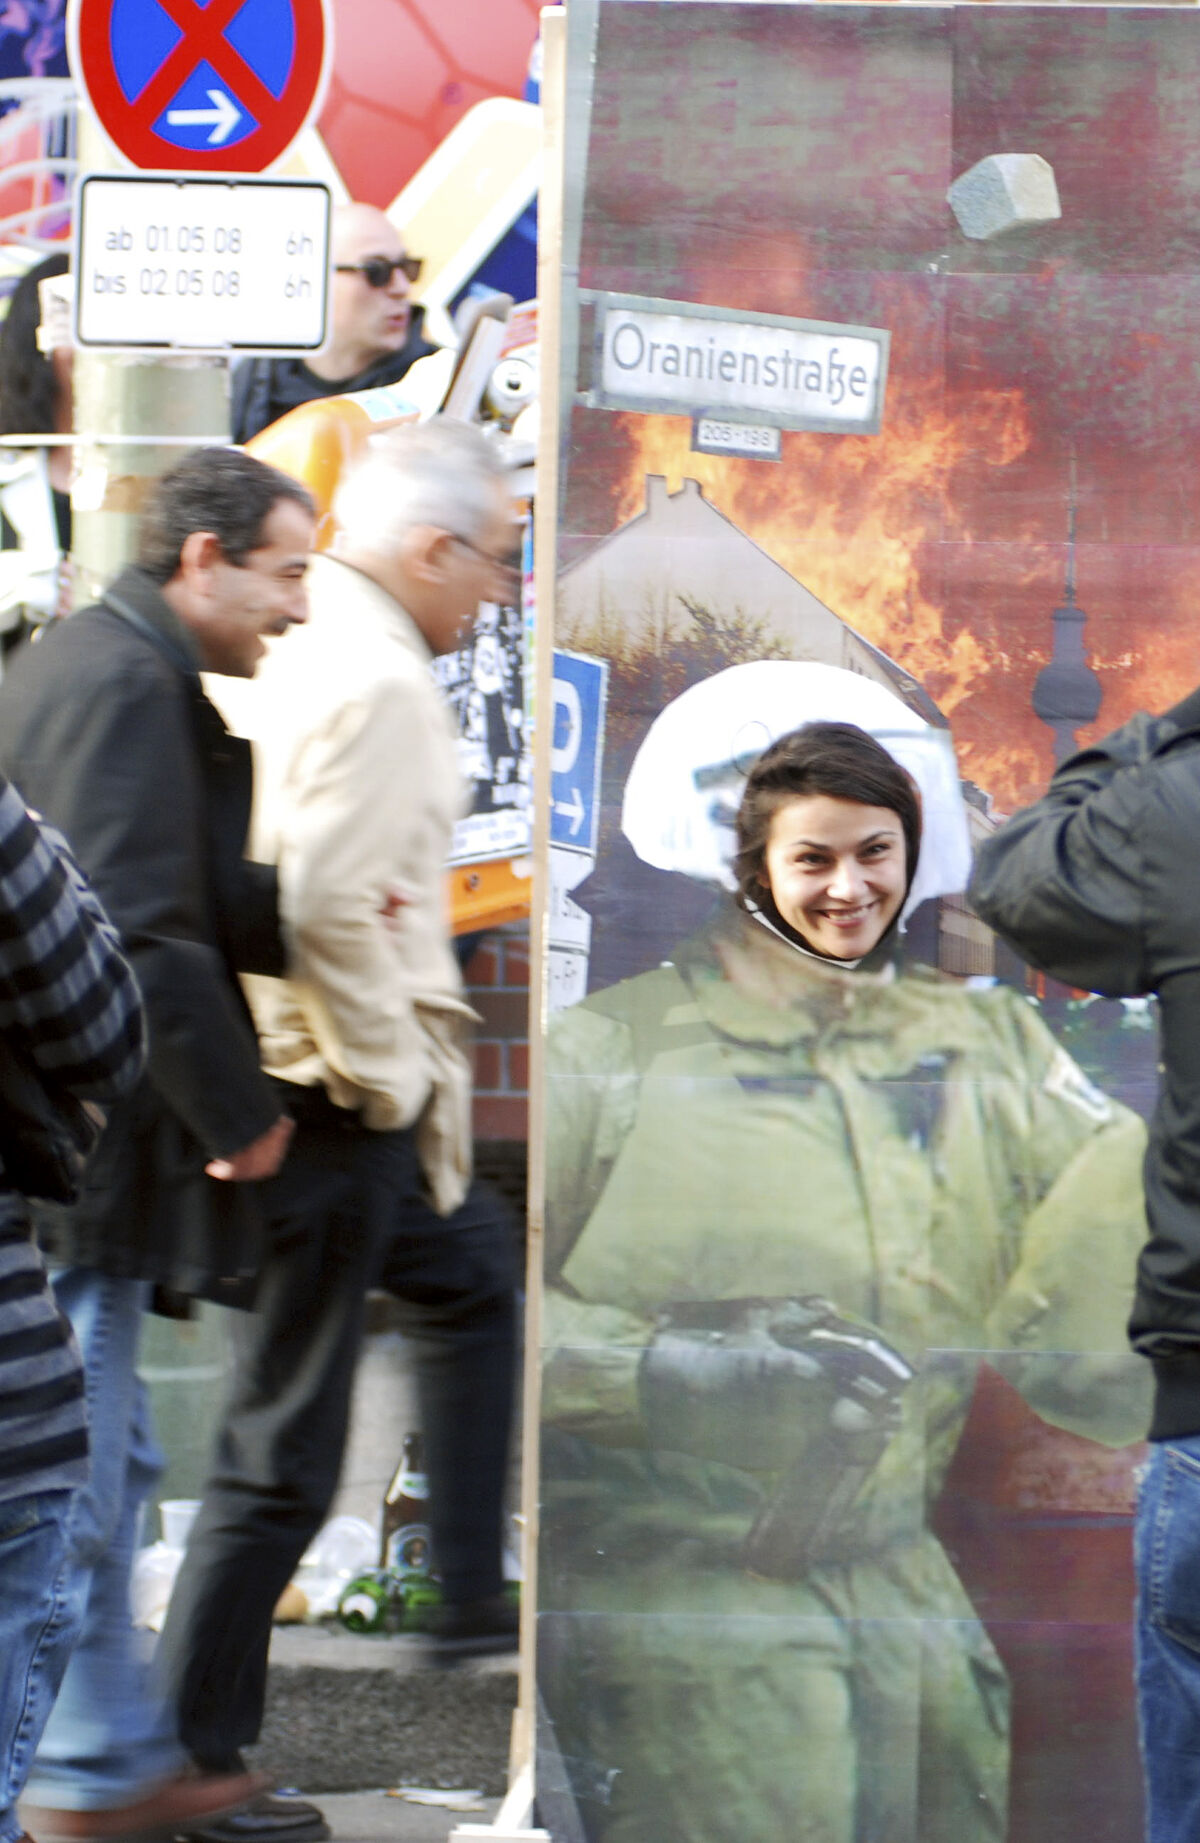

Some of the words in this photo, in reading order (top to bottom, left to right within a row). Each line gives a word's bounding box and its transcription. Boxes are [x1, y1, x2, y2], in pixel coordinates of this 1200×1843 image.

[105, 225, 134, 252] ab
[285, 230, 314, 256] 6h
[92, 267, 128, 295] bis
[283, 273, 313, 299] 6h
[612, 322, 867, 405] Oranienstraße
